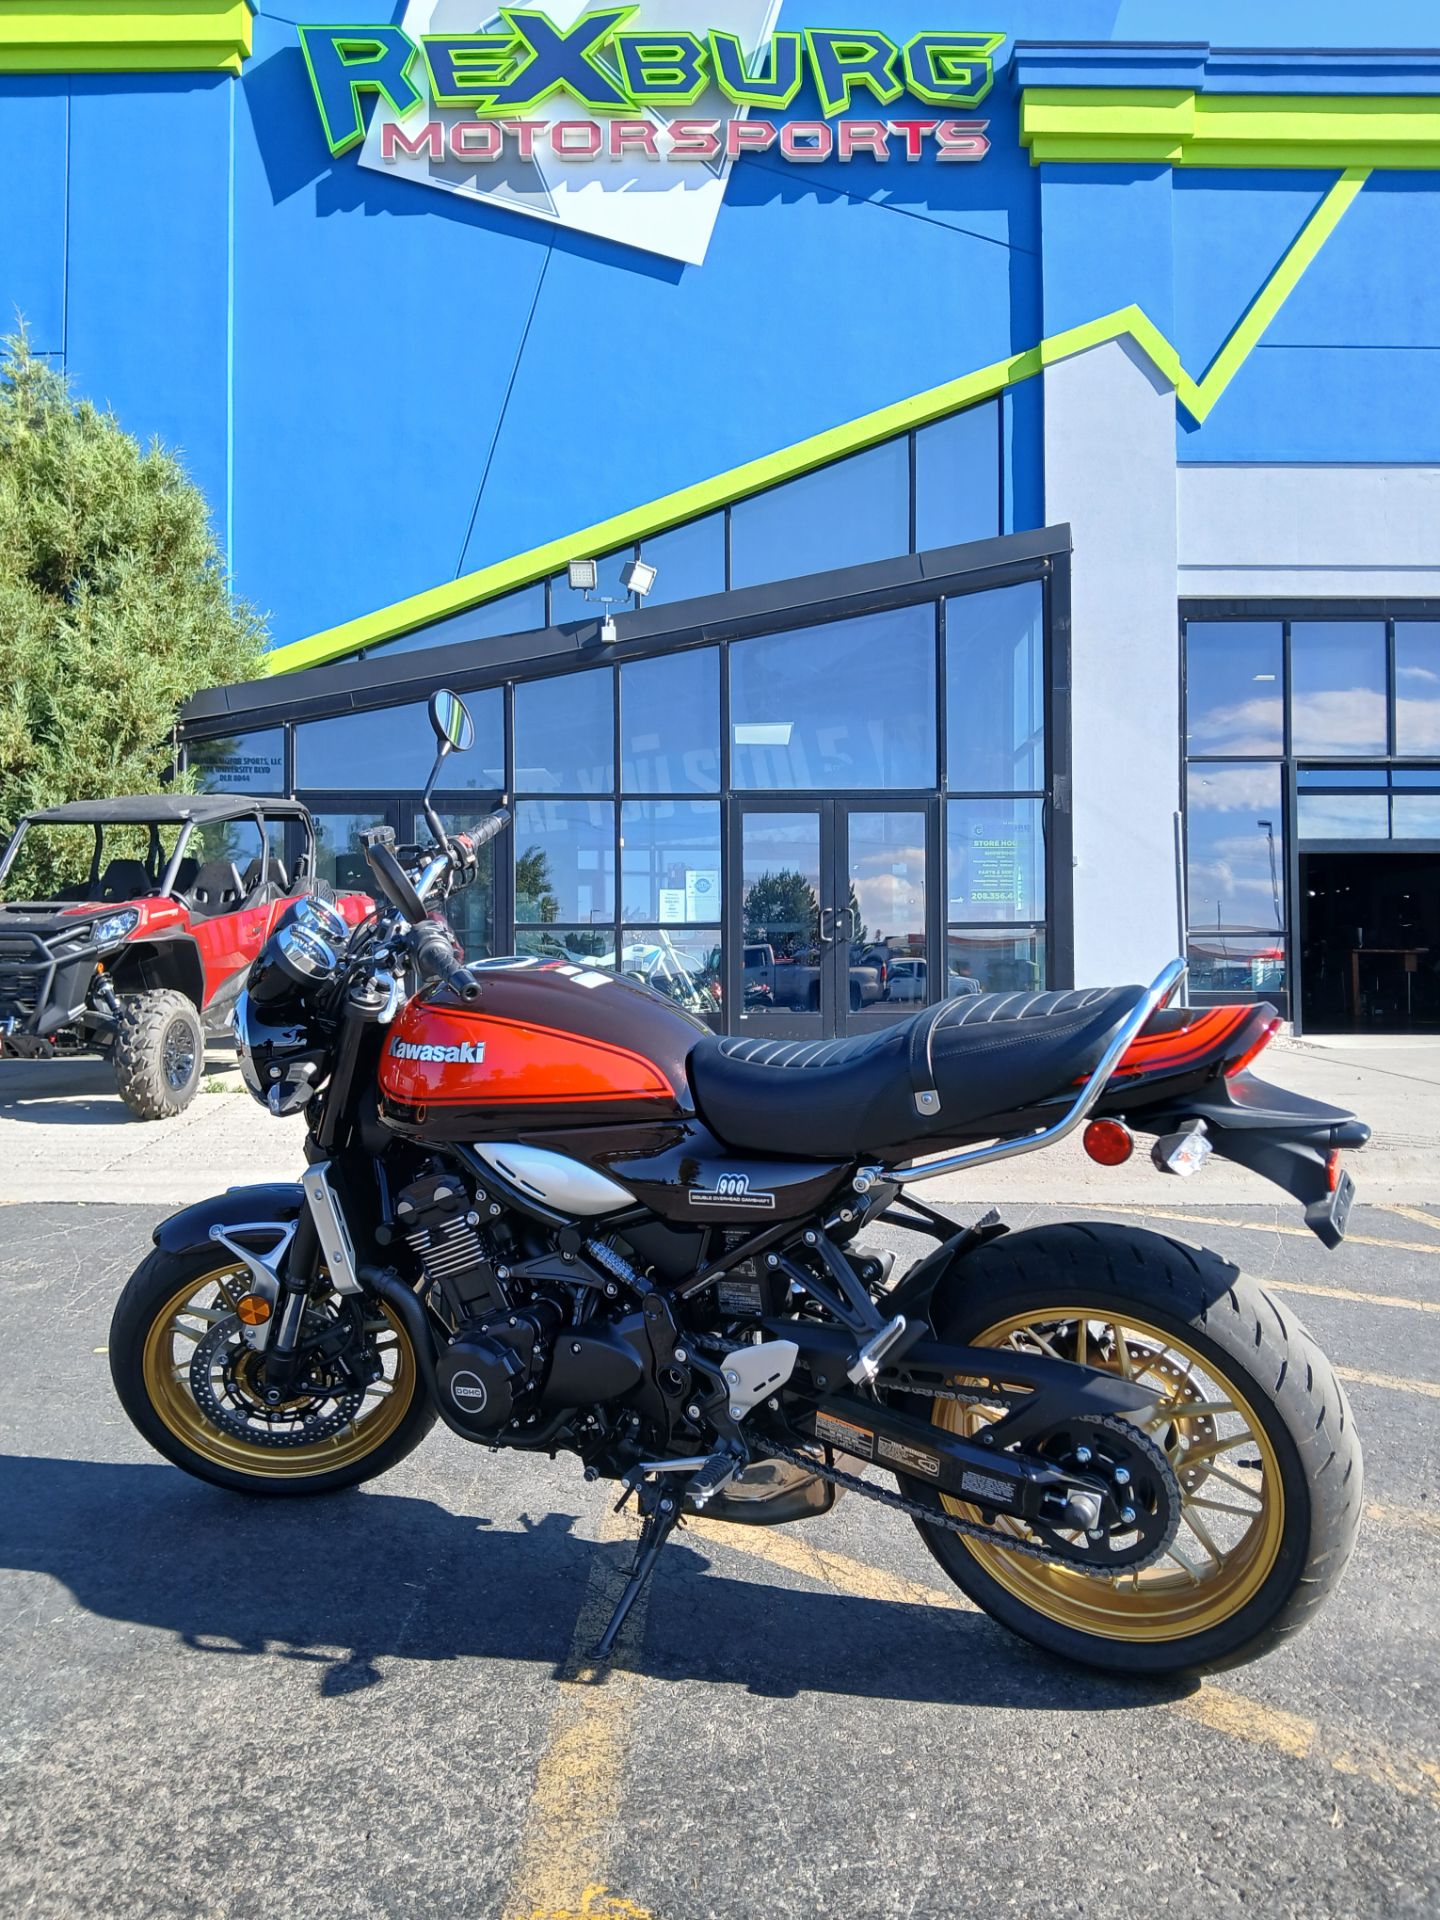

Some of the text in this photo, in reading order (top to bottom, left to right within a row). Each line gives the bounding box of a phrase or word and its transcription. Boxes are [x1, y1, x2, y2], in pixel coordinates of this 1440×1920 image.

[297, 5, 1007, 158] REXBURG
[382, 119, 992, 163] MOTORSPORTS
[243, 757, 269, 765] SPORTS,
[270, 757, 282, 765] LLC
[254, 766, 271, 774] BLVD
[388, 1035, 486, 1064] Kawasaki
[719, 1179, 745, 1195] 900
[457, 1388, 480, 1396] DOHC
